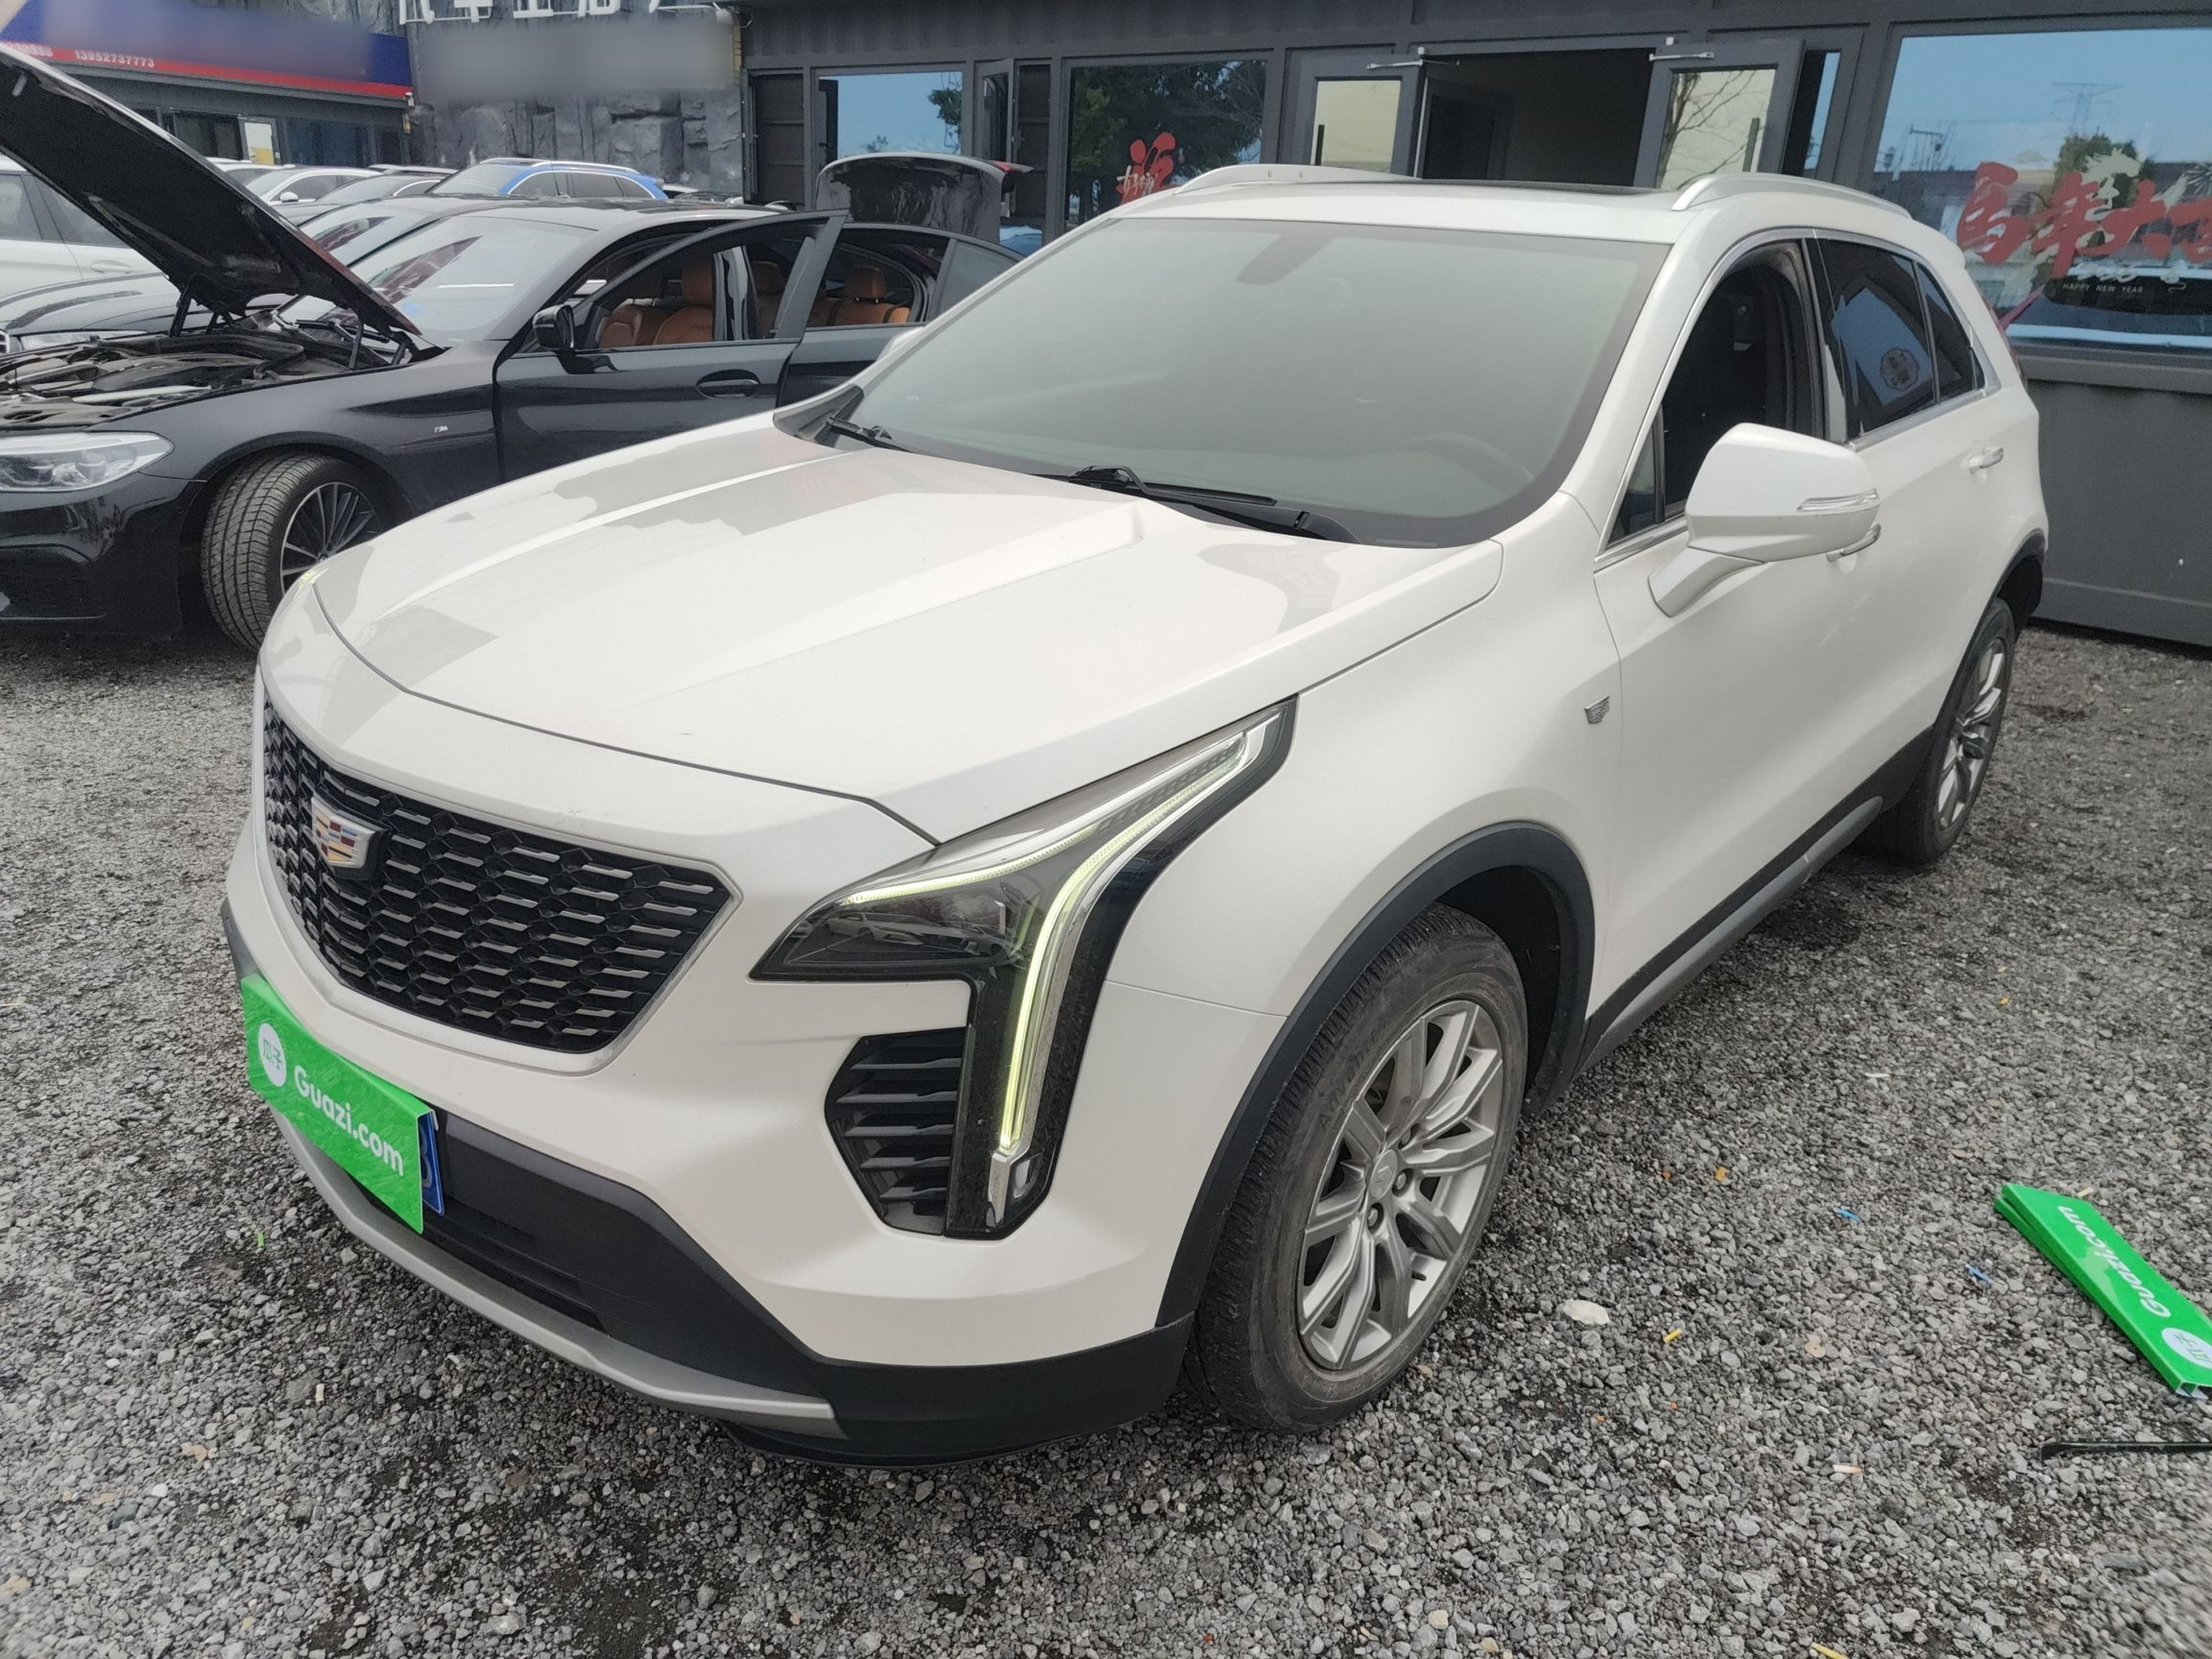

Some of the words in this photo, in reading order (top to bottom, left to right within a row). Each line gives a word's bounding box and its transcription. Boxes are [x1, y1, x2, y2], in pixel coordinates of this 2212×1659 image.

[263, 1037, 283, 1070] 瓜子
[294, 1065, 403, 1176] Guazi.com
[2058, 1205, 2171, 1318] Guazi.com
